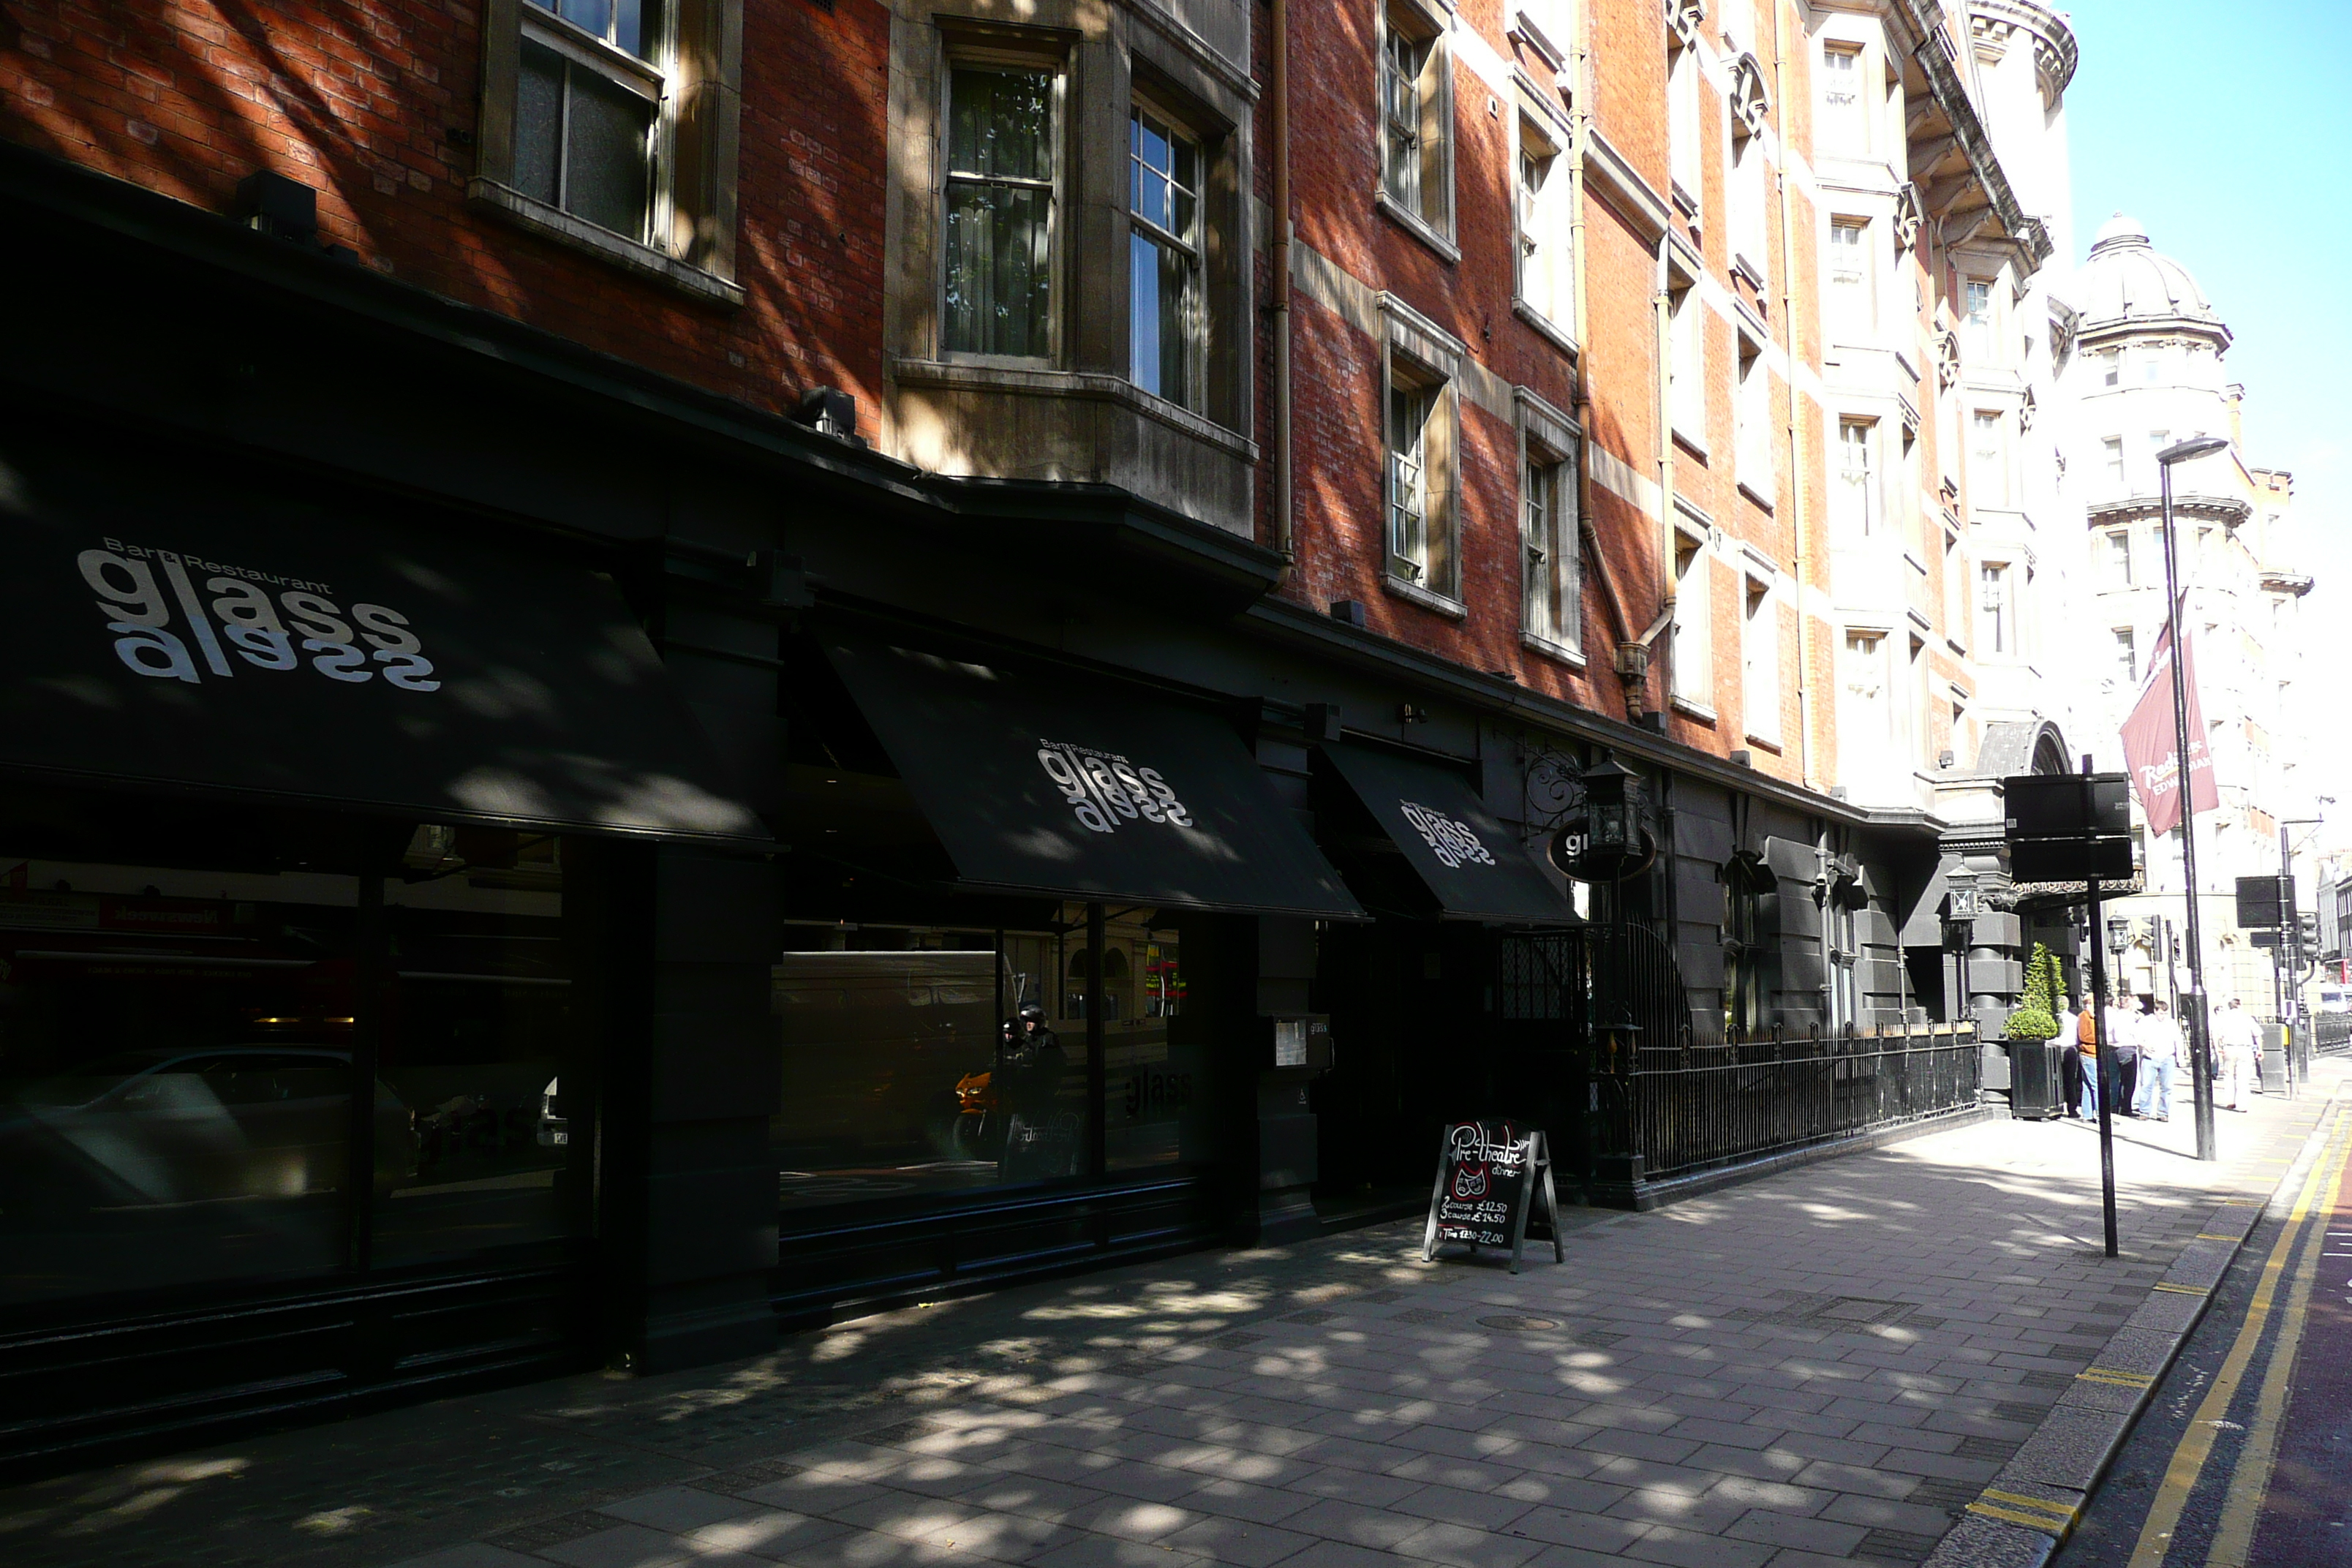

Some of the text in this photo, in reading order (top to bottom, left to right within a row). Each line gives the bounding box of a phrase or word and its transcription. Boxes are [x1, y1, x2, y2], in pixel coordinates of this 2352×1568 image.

[103, 537, 333, 595] Bar & Restaurant
[78, 549, 422, 655] glass
[1039, 738, 1060, 750] Bar
[1069, 744, 1129, 764] Restaurant
[1037, 743, 1176, 802] glass
[1401, 804, 1480, 848] glass
[1492, 1163, 1520, 1177] dinner
[1440, 1208, 1506, 1224] 3 course £14.50
[1441, 1196, 1507, 1213] 2 course £12.50
